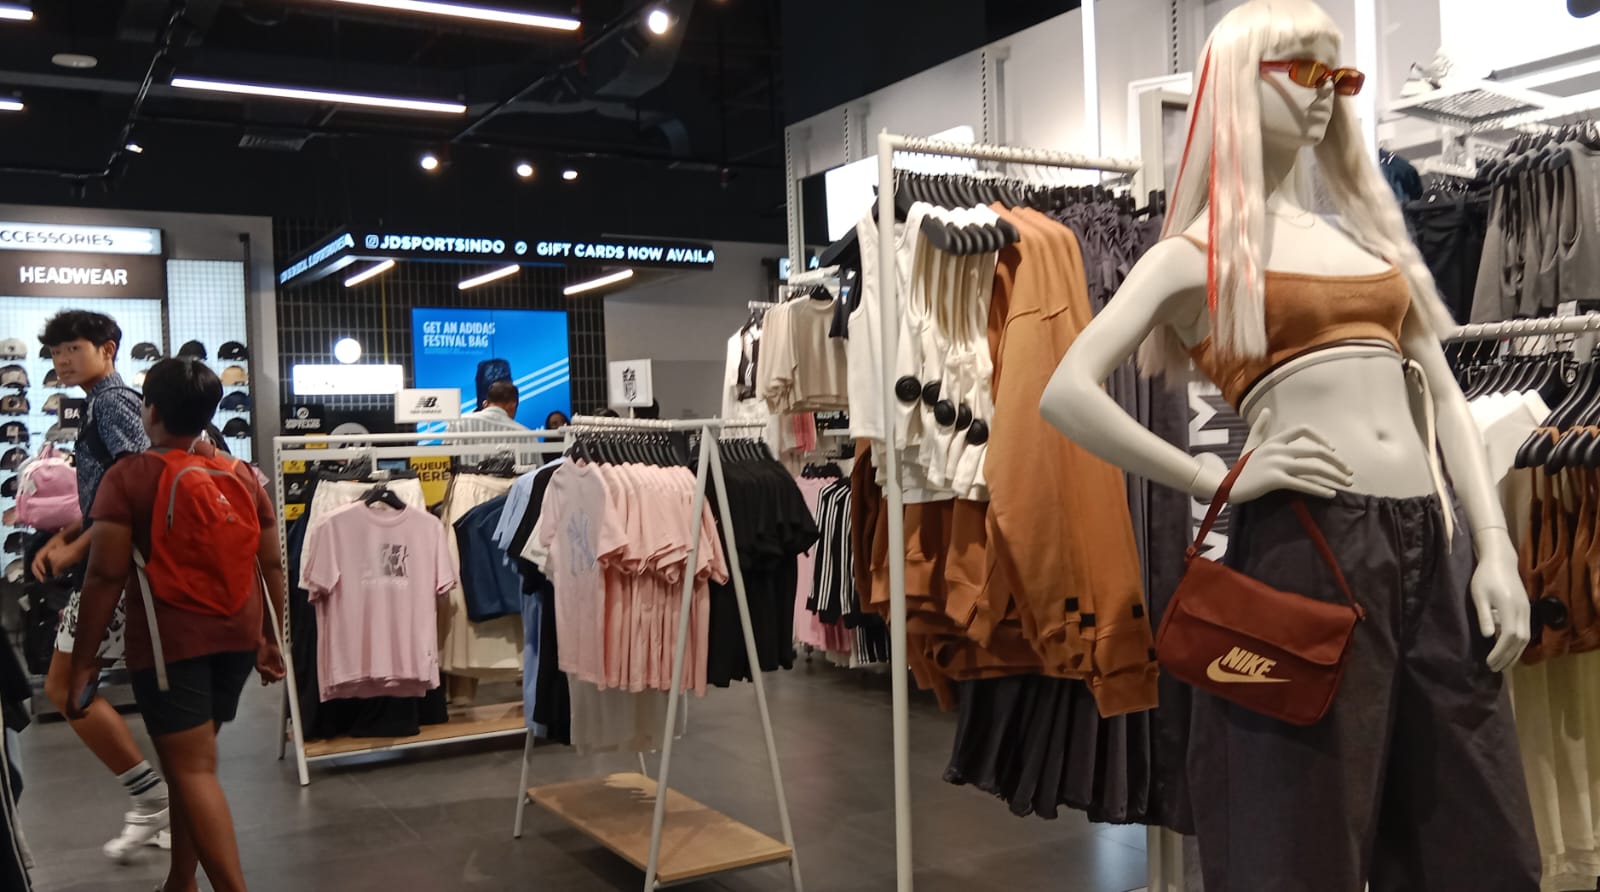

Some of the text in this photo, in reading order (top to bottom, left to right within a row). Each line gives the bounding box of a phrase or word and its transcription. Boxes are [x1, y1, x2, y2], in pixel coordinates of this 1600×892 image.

[380, 235, 506, 254] JDSPORTSINDO
[536, 242, 715, 263] GIFT CARDS NOW AVAILA
[19, 266, 128, 286] HEADWEAR
[423, 321, 496, 335] GET AN ADIDAS
[423, 335, 489, 348] FESTIVAL BAG
[64, 408, 81, 420] BA
[1220, 646, 1277, 678] NIKE
